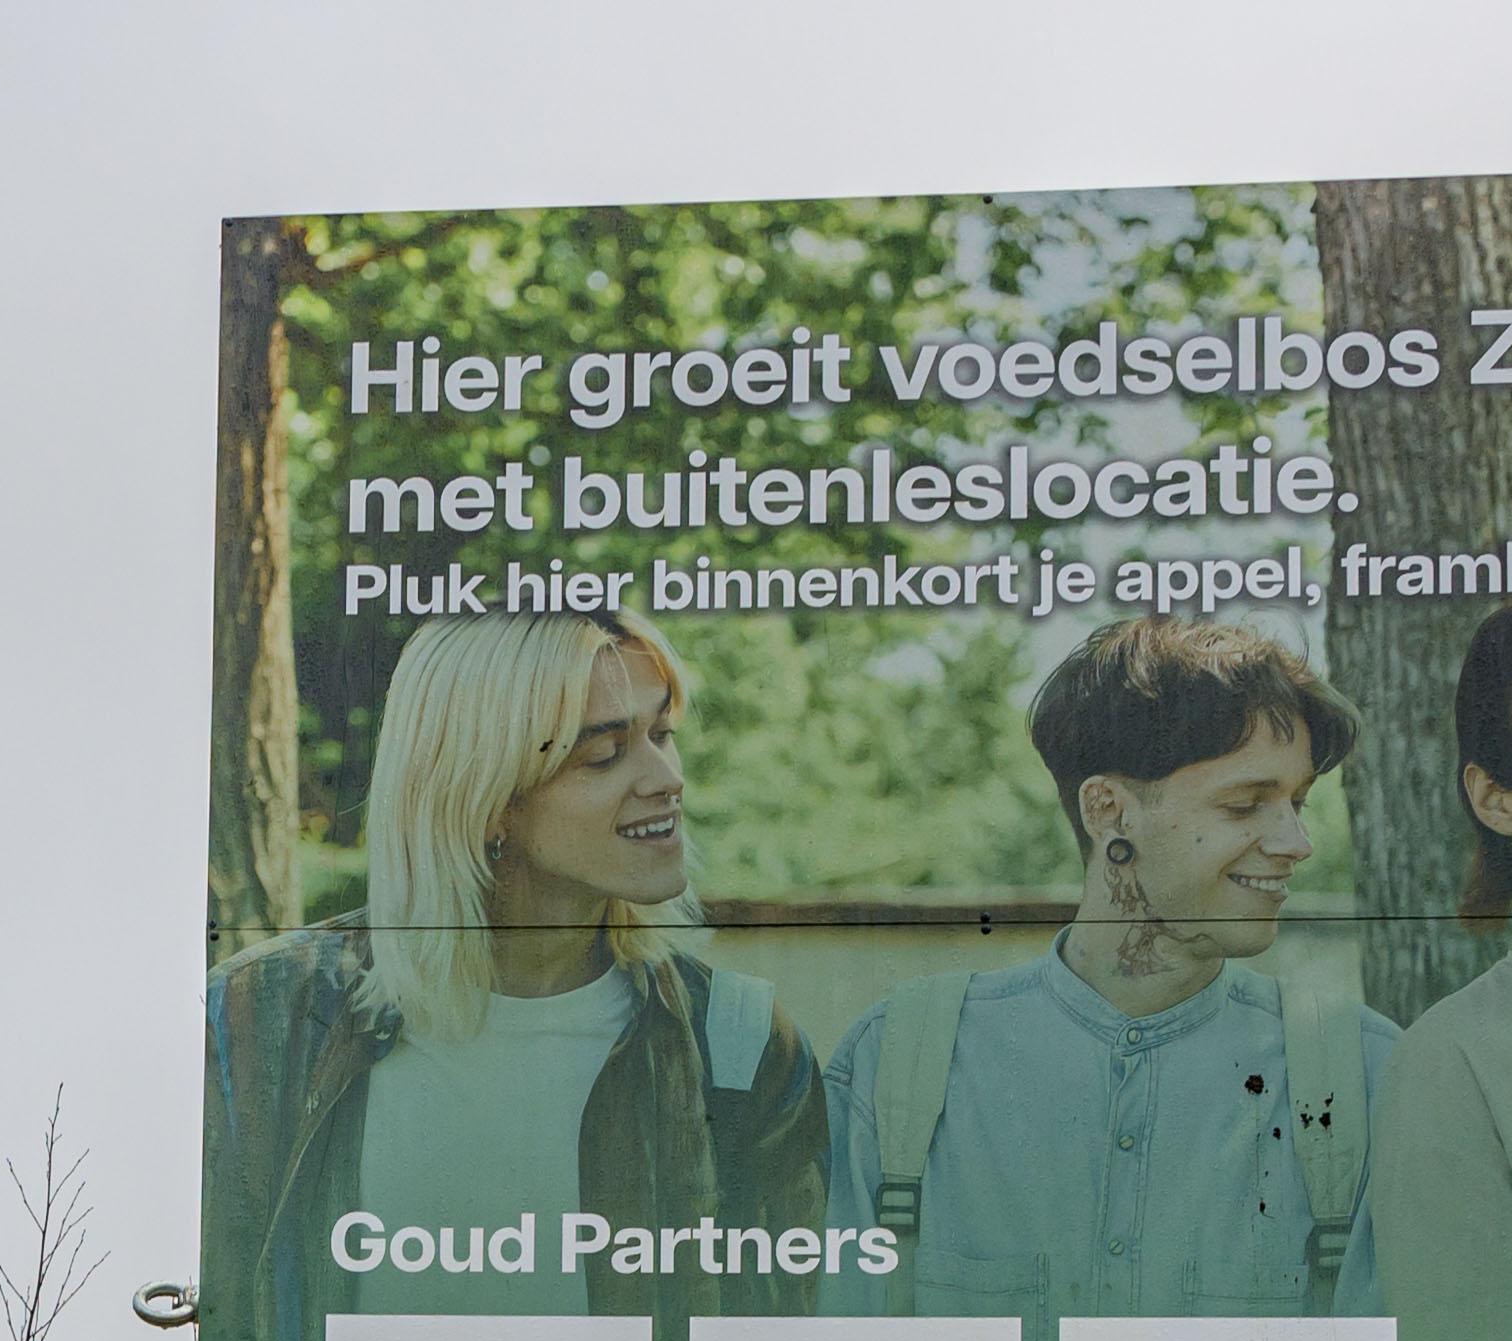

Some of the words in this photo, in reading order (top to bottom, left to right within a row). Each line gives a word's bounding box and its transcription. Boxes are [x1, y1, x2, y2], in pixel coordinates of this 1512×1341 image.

[348, 335, 543, 415] Hier
[568, 327, 852, 430] groeit
[879, 316, 1439, 402] voedselbos
[347, 458, 534, 535] met
[562, 436, 1359, 530] buitenleslocatie.
[345, 559, 487, 617] Pluk
[506, 558, 633, 612] hier
[651, 551, 1019, 610] binnenkort
[1030, 549, 1095, 618] je
[1114, 545, 1323, 616] appel,
[329, 1211, 537, 1276] Goud
[561, 1213, 898, 1276] Partners
